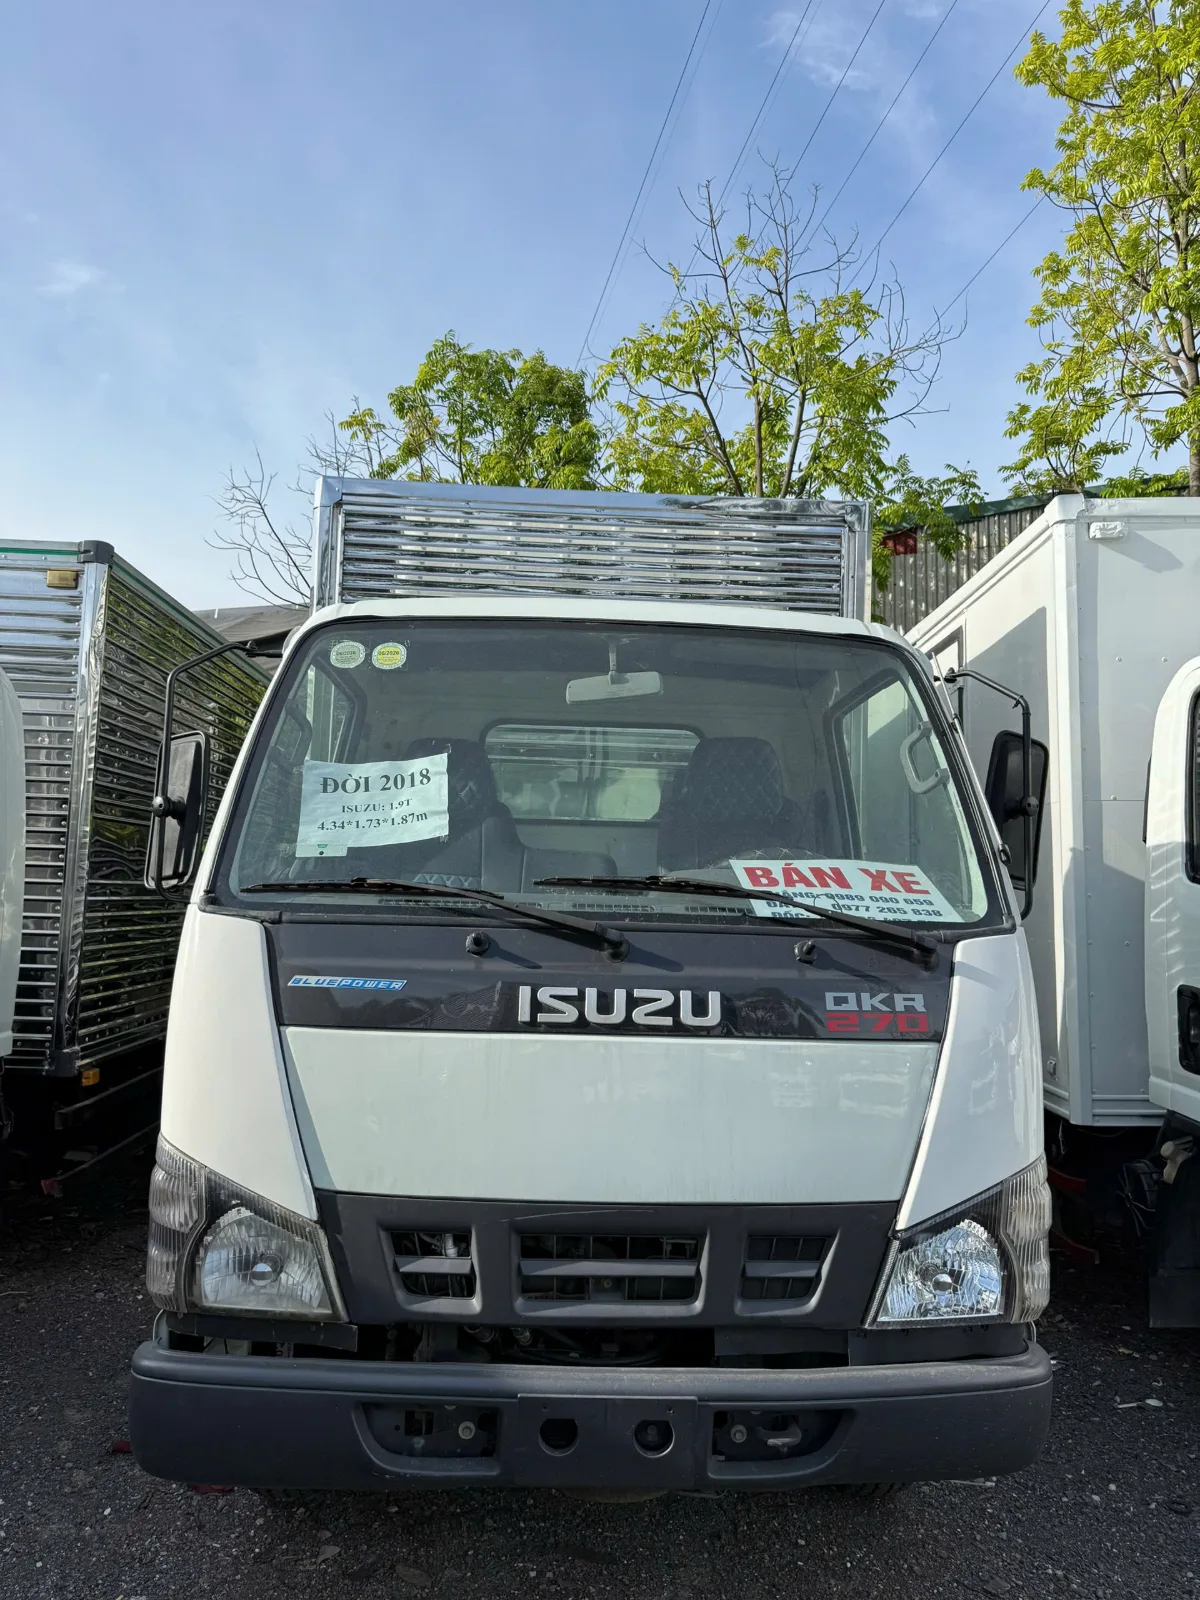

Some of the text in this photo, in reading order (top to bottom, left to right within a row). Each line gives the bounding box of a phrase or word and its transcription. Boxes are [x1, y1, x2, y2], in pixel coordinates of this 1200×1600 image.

[320, 768, 431, 794] ĐỜI 2018
[342, 798, 412, 813] ISUZU: 1.9T
[743, 863, 931, 895] BÁN XE
[825, 893, 865, 902] 0989
[868, 895, 899, 904] 090
[831, 903, 870, 912] 0977
[876, 906, 908, 915] 265
[289, 976, 403, 990] BLUEPOWER
[518, 986, 721, 1028] ISUZU
[825, 991, 925, 1012] QKR
[826, 1012, 929, 1033] 270
